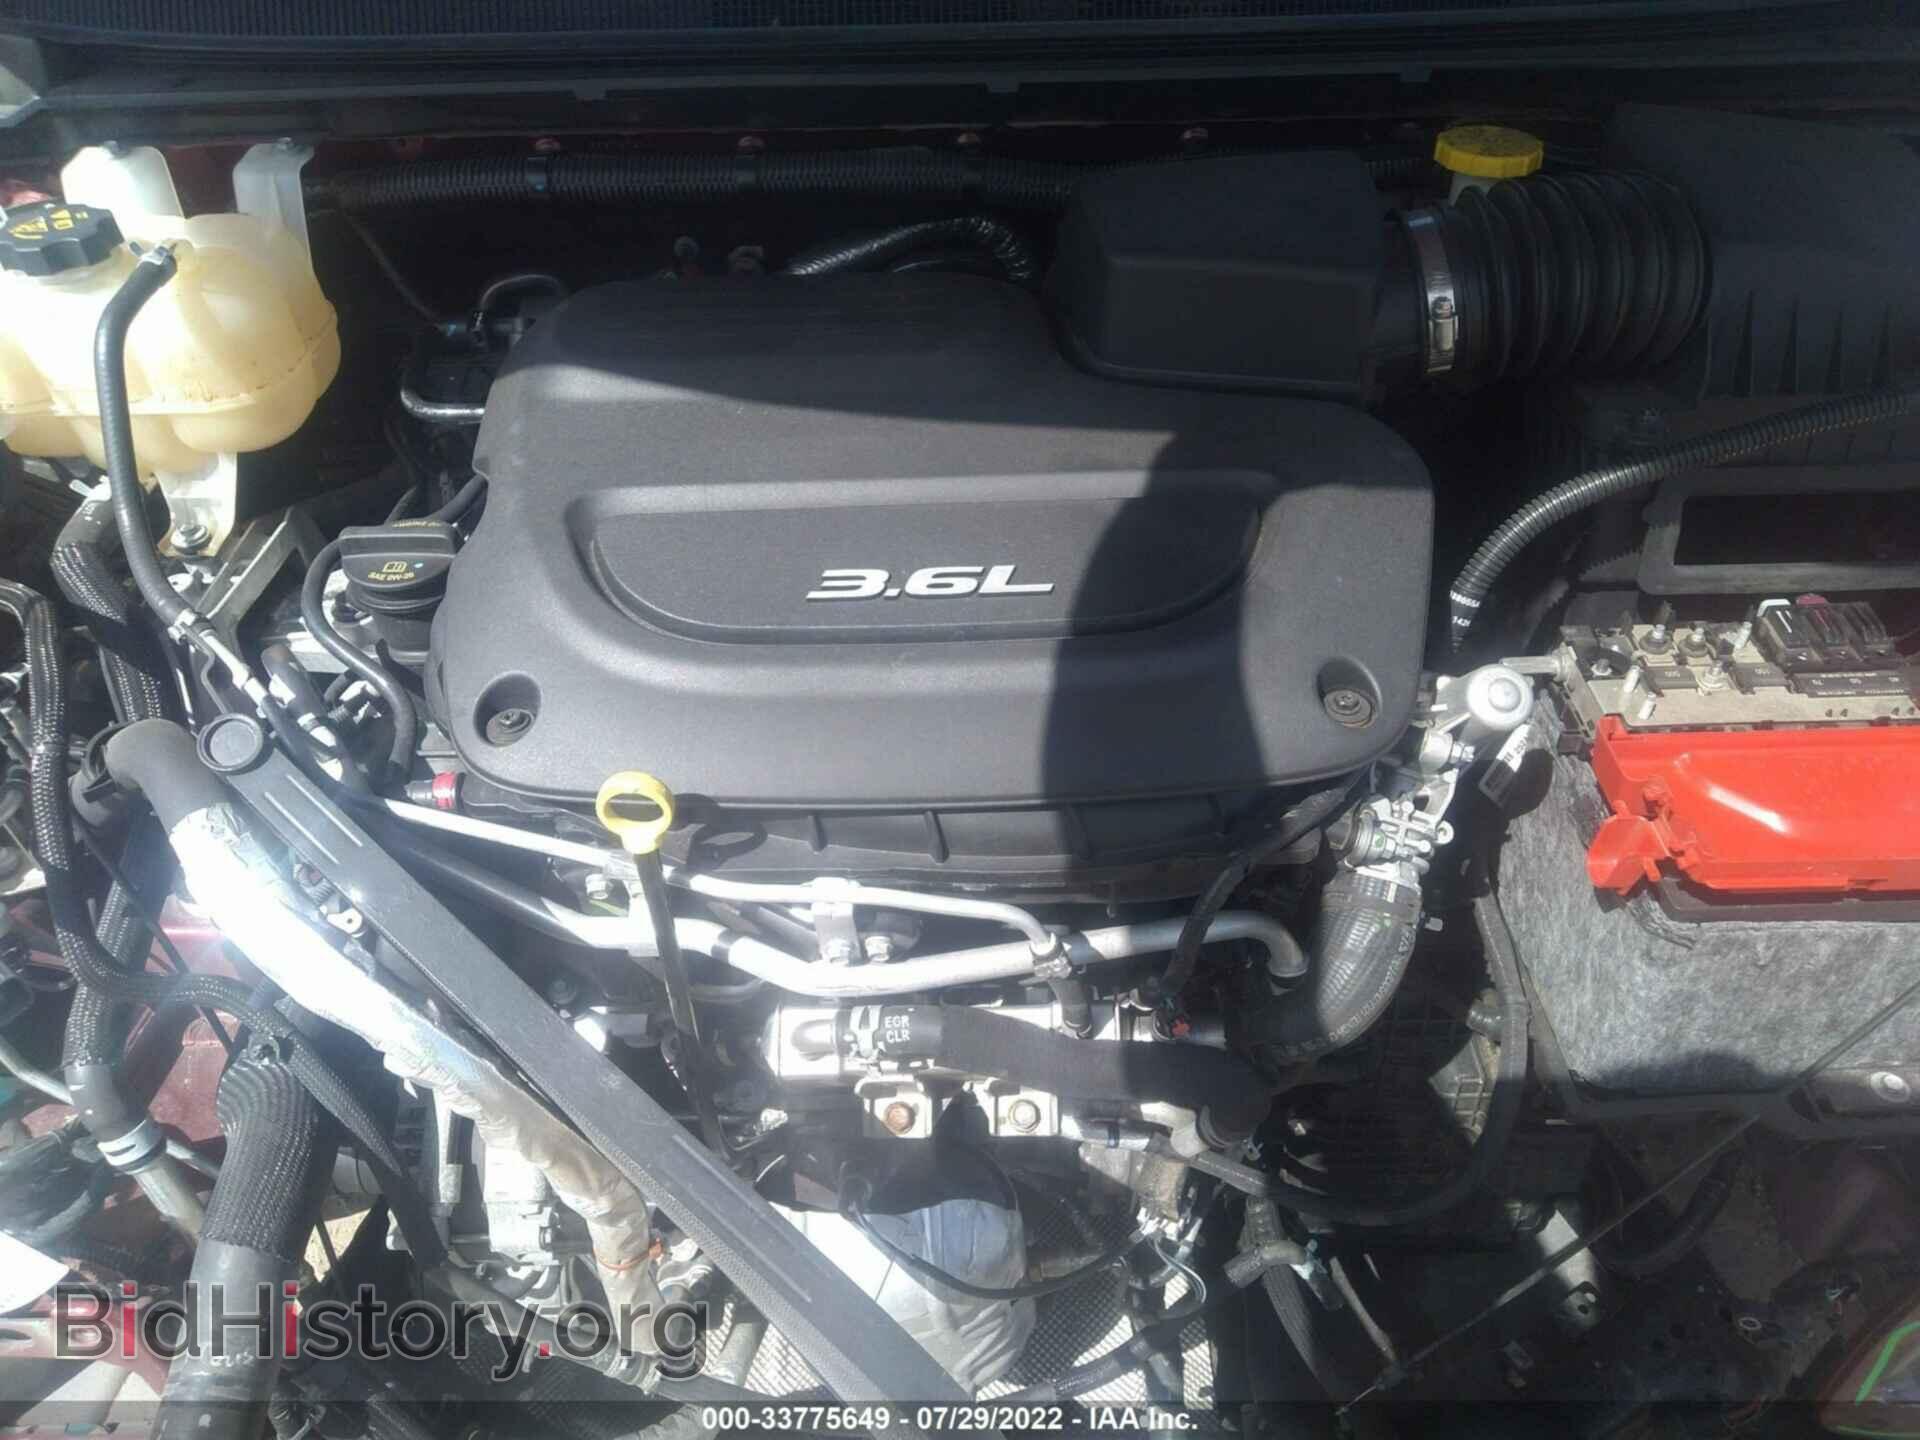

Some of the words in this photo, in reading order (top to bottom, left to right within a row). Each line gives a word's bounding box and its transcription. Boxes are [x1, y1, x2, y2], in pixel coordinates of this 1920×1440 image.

[806, 564, 1055, 602] 3.6L
[884, 1015, 910, 1029] EGR
[886, 1029, 911, 1043] CLR
